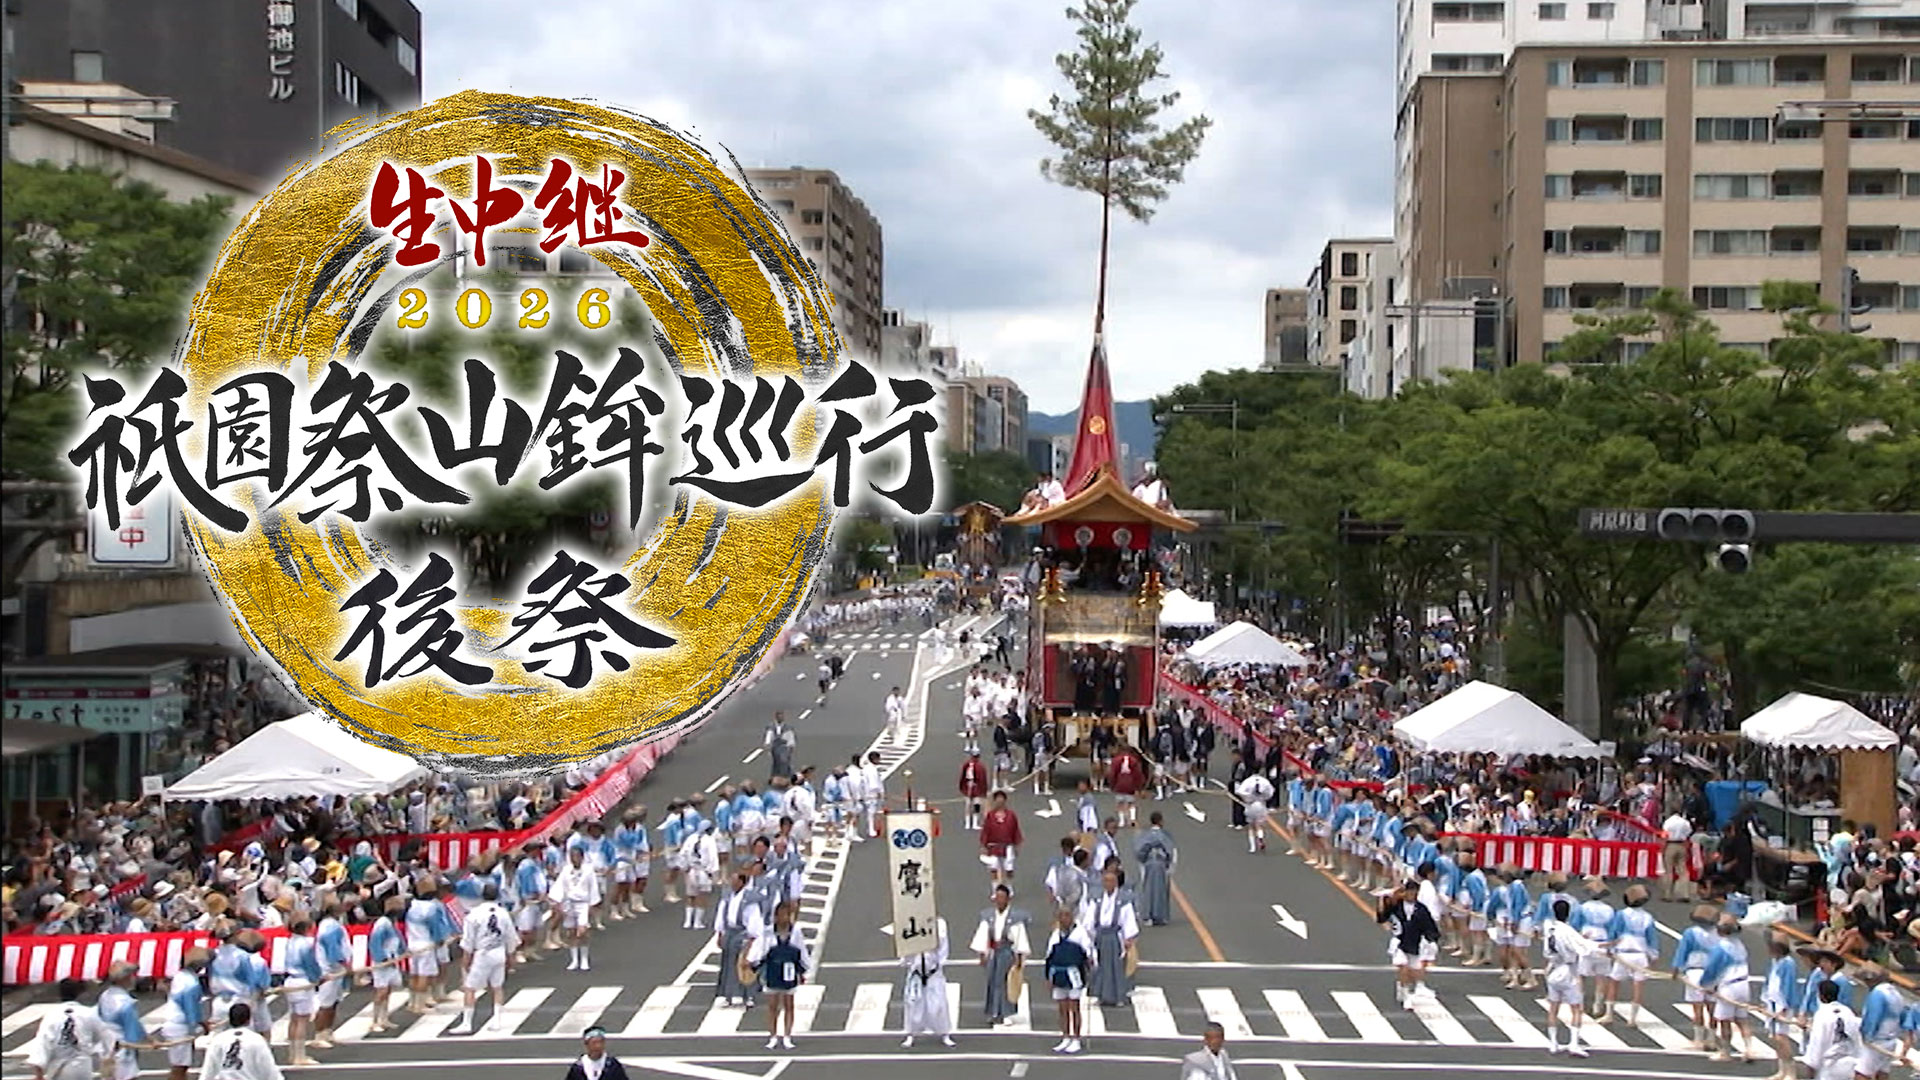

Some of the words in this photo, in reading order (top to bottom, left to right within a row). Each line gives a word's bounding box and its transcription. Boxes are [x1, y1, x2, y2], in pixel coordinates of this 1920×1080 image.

[268, 0, 294, 100] 御池ビル
[897, 858, 927, 940] 鷹山
